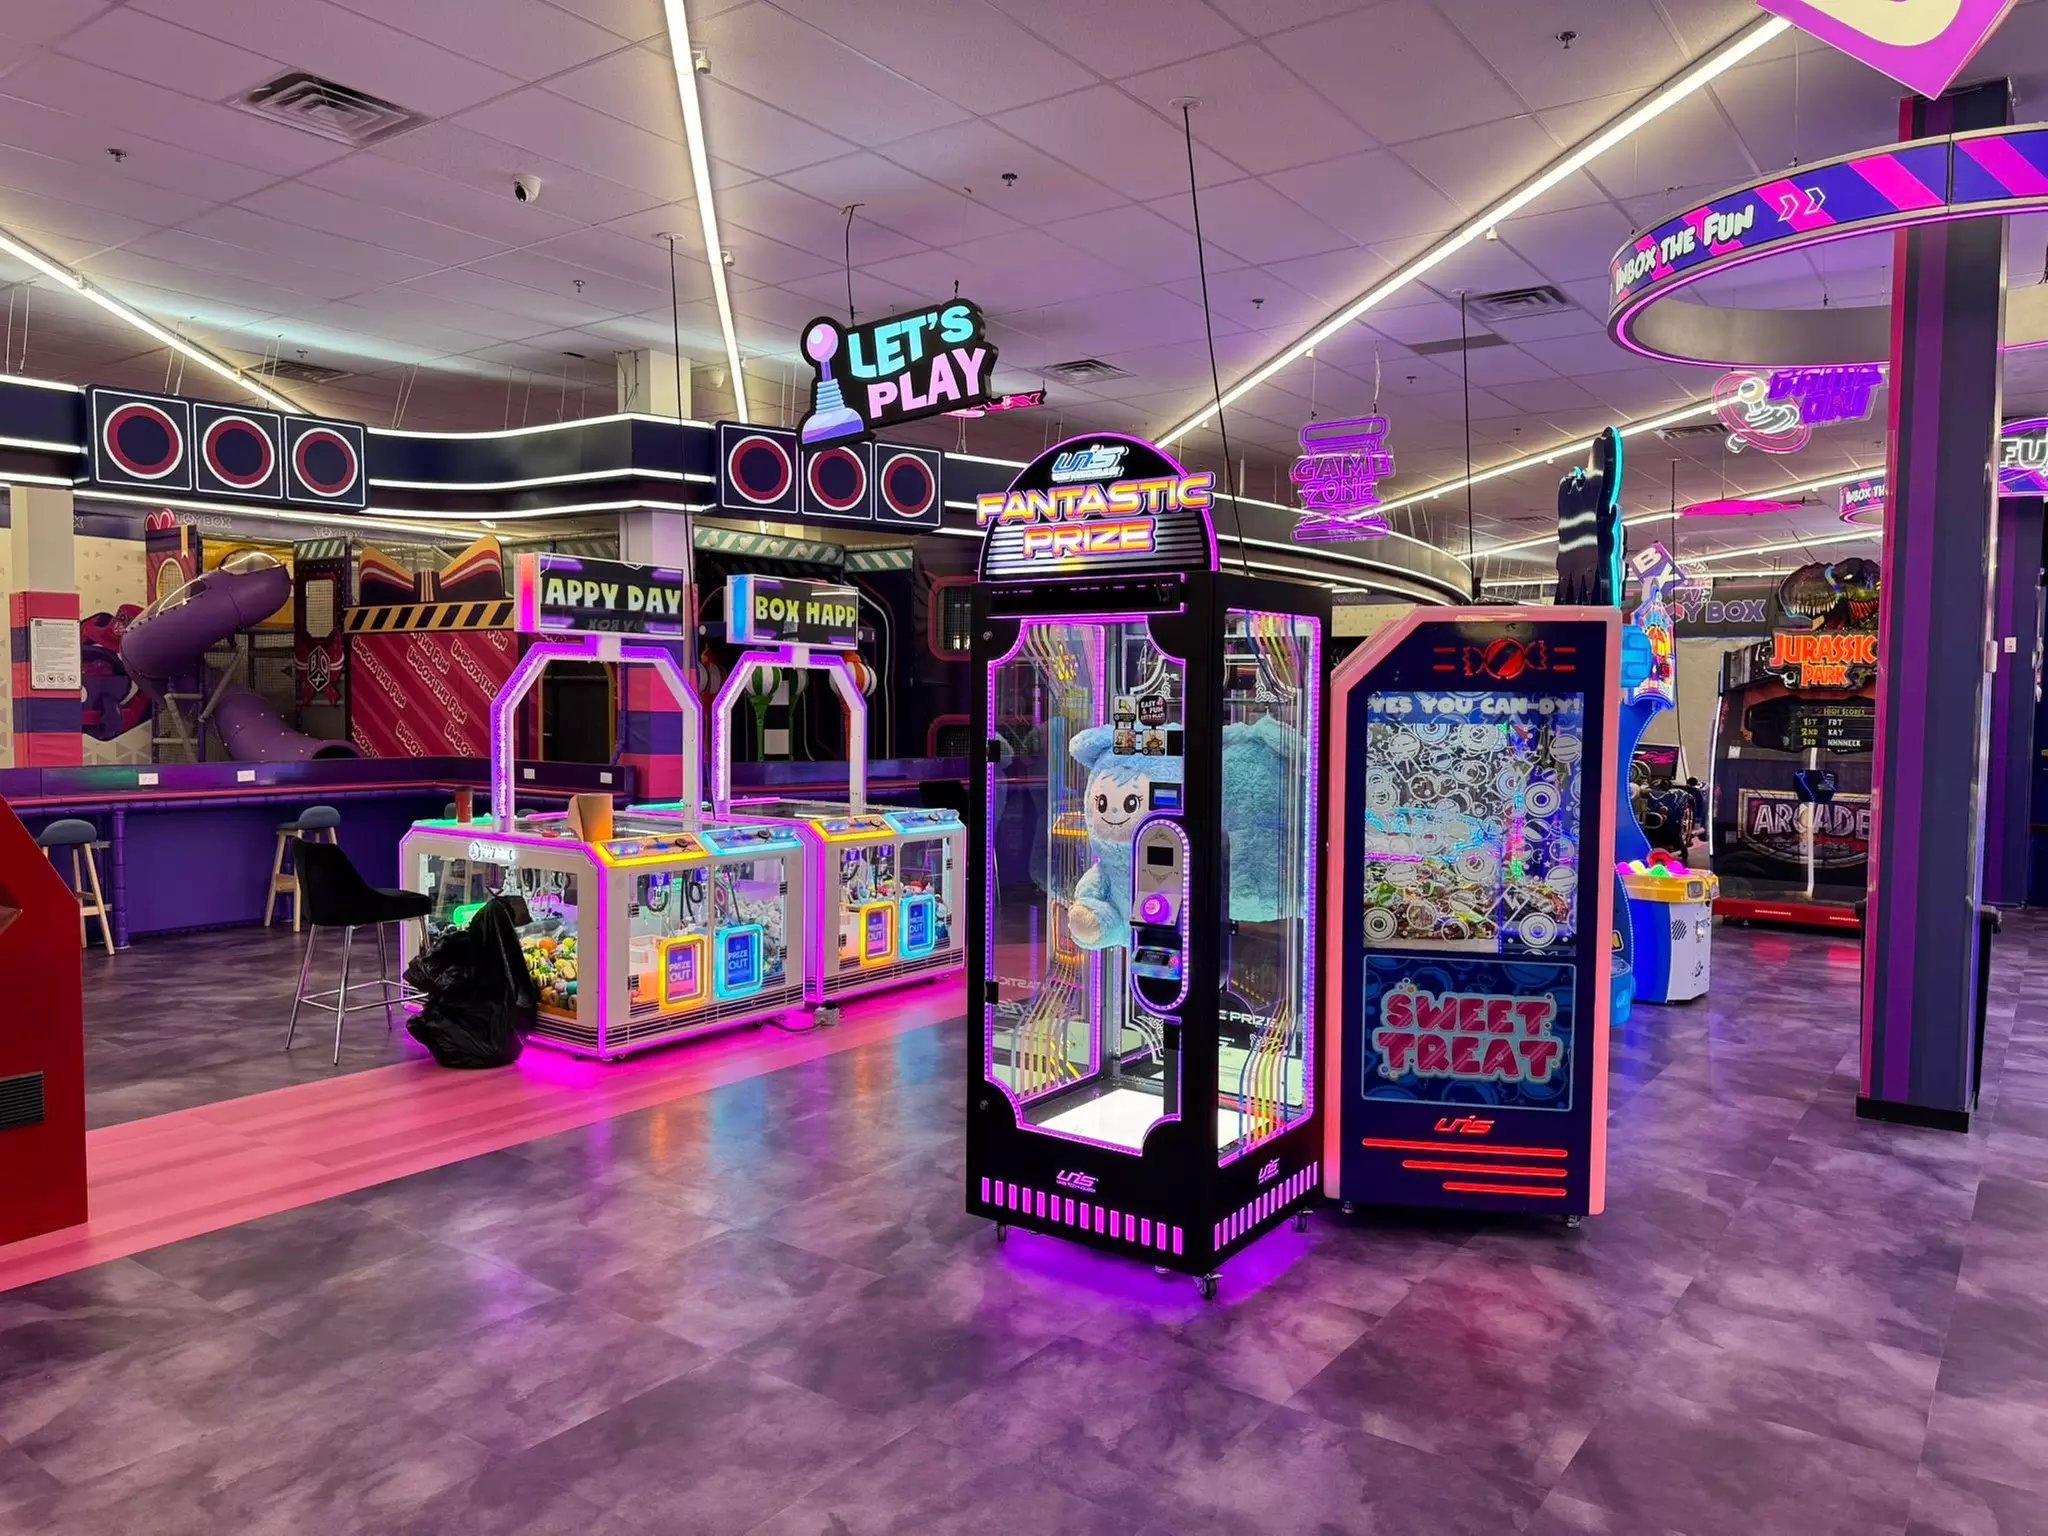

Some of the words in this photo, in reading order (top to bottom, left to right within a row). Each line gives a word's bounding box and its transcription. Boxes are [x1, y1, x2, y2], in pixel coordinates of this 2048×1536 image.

[1615, 244, 1658, 294] UNBOX
[1660, 224, 1696, 265] THE
[1702, 204, 1754, 248] FUN
[847, 304, 975, 379] LET'S
[866, 347, 987, 419] PLAY
[1293, 450, 1391, 481] GAME
[1999, 438, 2048, 469] FU
[977, 472, 1216, 528] FANTASTIC
[1303, 478, 1379, 506] ZONE
[203, 515, 232, 529] BOX
[1023, 517, 1157, 559] PRIZE
[541, 577, 618, 610] APPY
[628, 585, 681, 614] DAY
[755, 596, 800, 623] BOX
[1705, 599, 1766, 623] BOX
[417, 633, 434, 656] THE
[432, 648, 450, 674] FUN
[451, 638, 484, 683] UNBOX
[1770, 634, 1877, 667] JURASSIC
[352, 635, 378, 674] UNBOX
[376, 667, 392, 691] THE
[389, 683, 407, 709] FUN
[406, 645, 437, 688] UNBOX
[433, 682, 450, 706] THE
[447, 698, 467, 725] FUN
[1801, 664, 1850, 687] PARK
[1367, 697, 1412, 714] YES
[1420, 697, 1474, 714] YOU
[1828, 728, 1844, 737] KAY
[1753, 803, 1871, 840] ARCADE
[669, 969, 692, 981] OUT
[729, 959, 749, 971] OUT
[1384, 991, 1555, 1038] SWEET
[1375, 1030, 1561, 1080] TREAT
